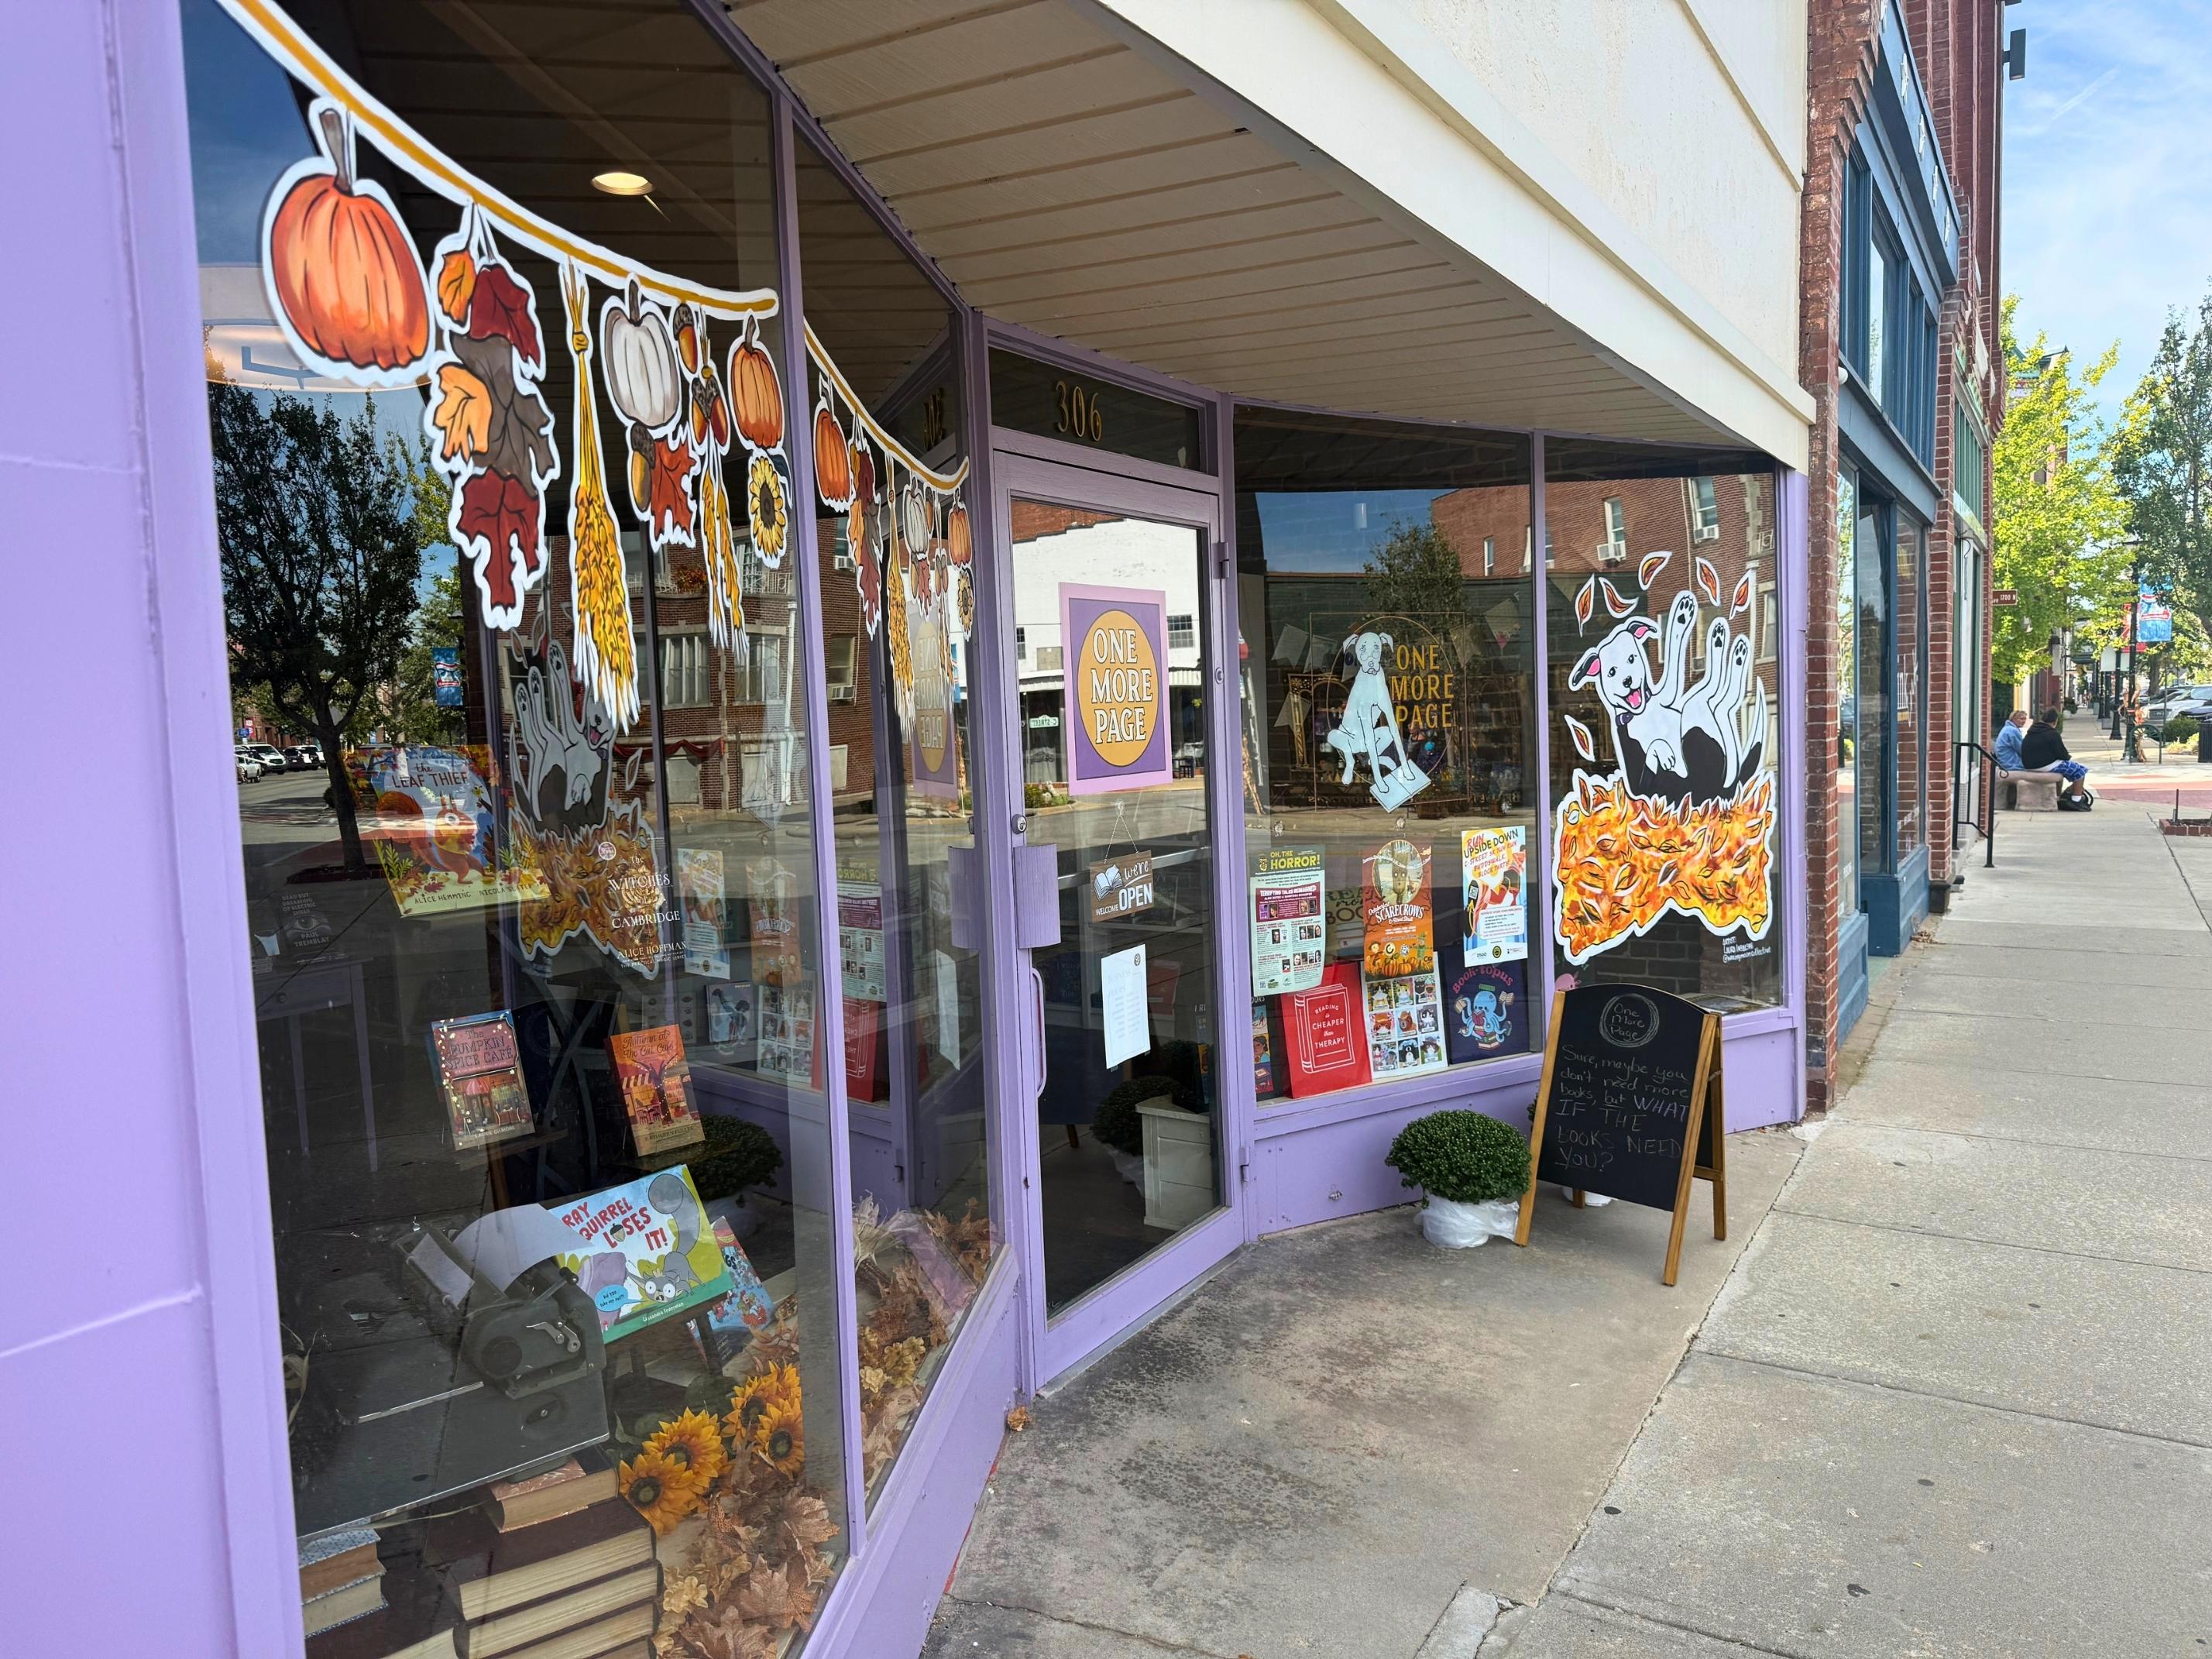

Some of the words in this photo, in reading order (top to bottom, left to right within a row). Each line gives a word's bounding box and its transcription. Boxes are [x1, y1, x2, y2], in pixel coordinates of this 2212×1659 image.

[1055, 380, 1102, 441] 306
[1092, 627, 1139, 665] ONE
[1396, 644, 1441, 671] ONE
[1091, 668, 1153, 704] MORE
[1391, 674, 1455, 701] MORE
[1094, 706, 1146, 744] PAGE
[1396, 703, 1453, 730] PAGE
[416, 762, 432, 773] the
[391, 775, 425, 788] LEAF
[428, 771, 468, 786] THIEF
[1464, 840, 1492, 858] UPSIDE
[1493, 828, 1519, 847] DOWN
[630, 856, 644, 865] The
[1125, 860, 1149, 880] we're
[1270, 854, 1321, 870] HORROR!
[608, 873, 671, 891] WITCHES
[414, 895, 436, 905] ALICE
[438, 891, 472, 902] HEMMING
[1118, 883, 1152, 912] OPEN
[1095, 904, 1119, 915] WELCOME
[1376, 904, 1424, 923] SCARECROWS
[612, 911, 681, 929] CAMBRIDGE
[294, 936, 330, 947] TREMBLAY
[617, 947, 644, 960] ALICE
[646, 940, 687, 954] HOFFMAN
[1314, 1005, 1339, 1015] READING
[1614, 1003, 1640, 1017] One
[1312, 1018, 1345, 1030] CHEAPER
[1612, 1014, 1646, 1028] More
[1314, 1037, 1345, 1049] THERAPY
[1610, 1024, 1640, 1042] Page
[449, 1036, 505, 1055] PUMPKIN
[445, 1054, 480, 1070] SPICE
[1562, 1045, 1599, 1069] Sure,
[1602, 1056, 1649, 1082] maybe
[1652, 1066, 1688, 1084] you
[1561, 1066, 1592, 1083] don't
[1603, 1077, 1639, 1091] need
[1644, 1084, 1689, 1098] more
[1555, 1098, 1587, 1116] IF
[1598, 1107, 1647, 1132] THE
[1604, 1090, 1626, 1106] but
[1633, 1094, 1689, 1122] WHAT
[1626, 1135, 1682, 1159] NEED
[562, 1201, 590, 1227] RAY
[579, 1197, 633, 1241] QUIRREL
[644, 1227, 668, 1251] IT!
